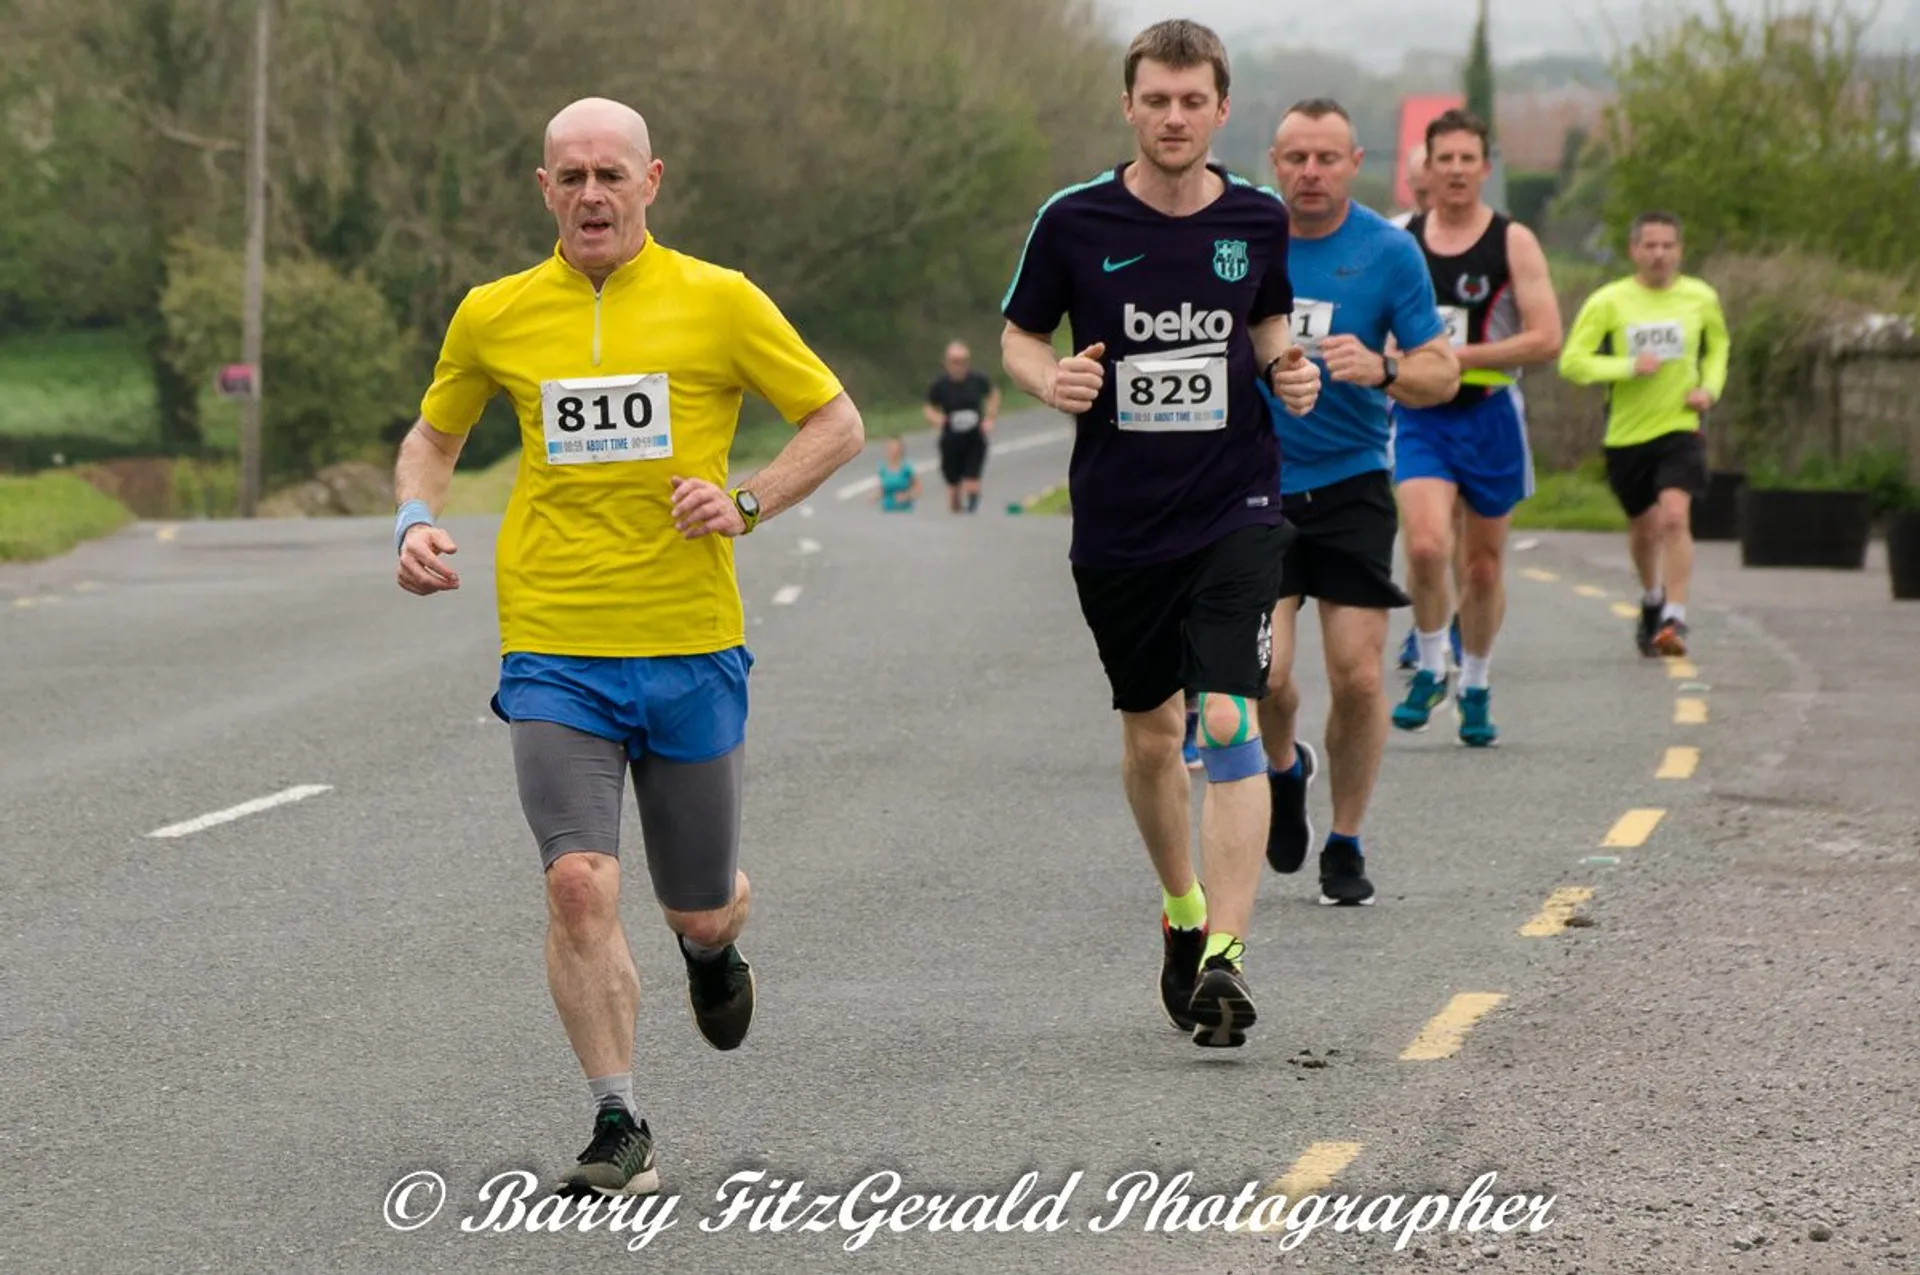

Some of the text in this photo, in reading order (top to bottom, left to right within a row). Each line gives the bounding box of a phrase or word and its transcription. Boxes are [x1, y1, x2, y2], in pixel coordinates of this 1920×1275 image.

[1124, 302, 1233, 341] beko
[1130, 374, 1212, 405] 829
[557, 392, 653, 432] 810
[1154, 411, 1174, 422] ABOUT
[1175, 411, 1190, 422] TIME
[586, 439, 608, 452] ABOUT
[610, 438, 628, 450] TIME
